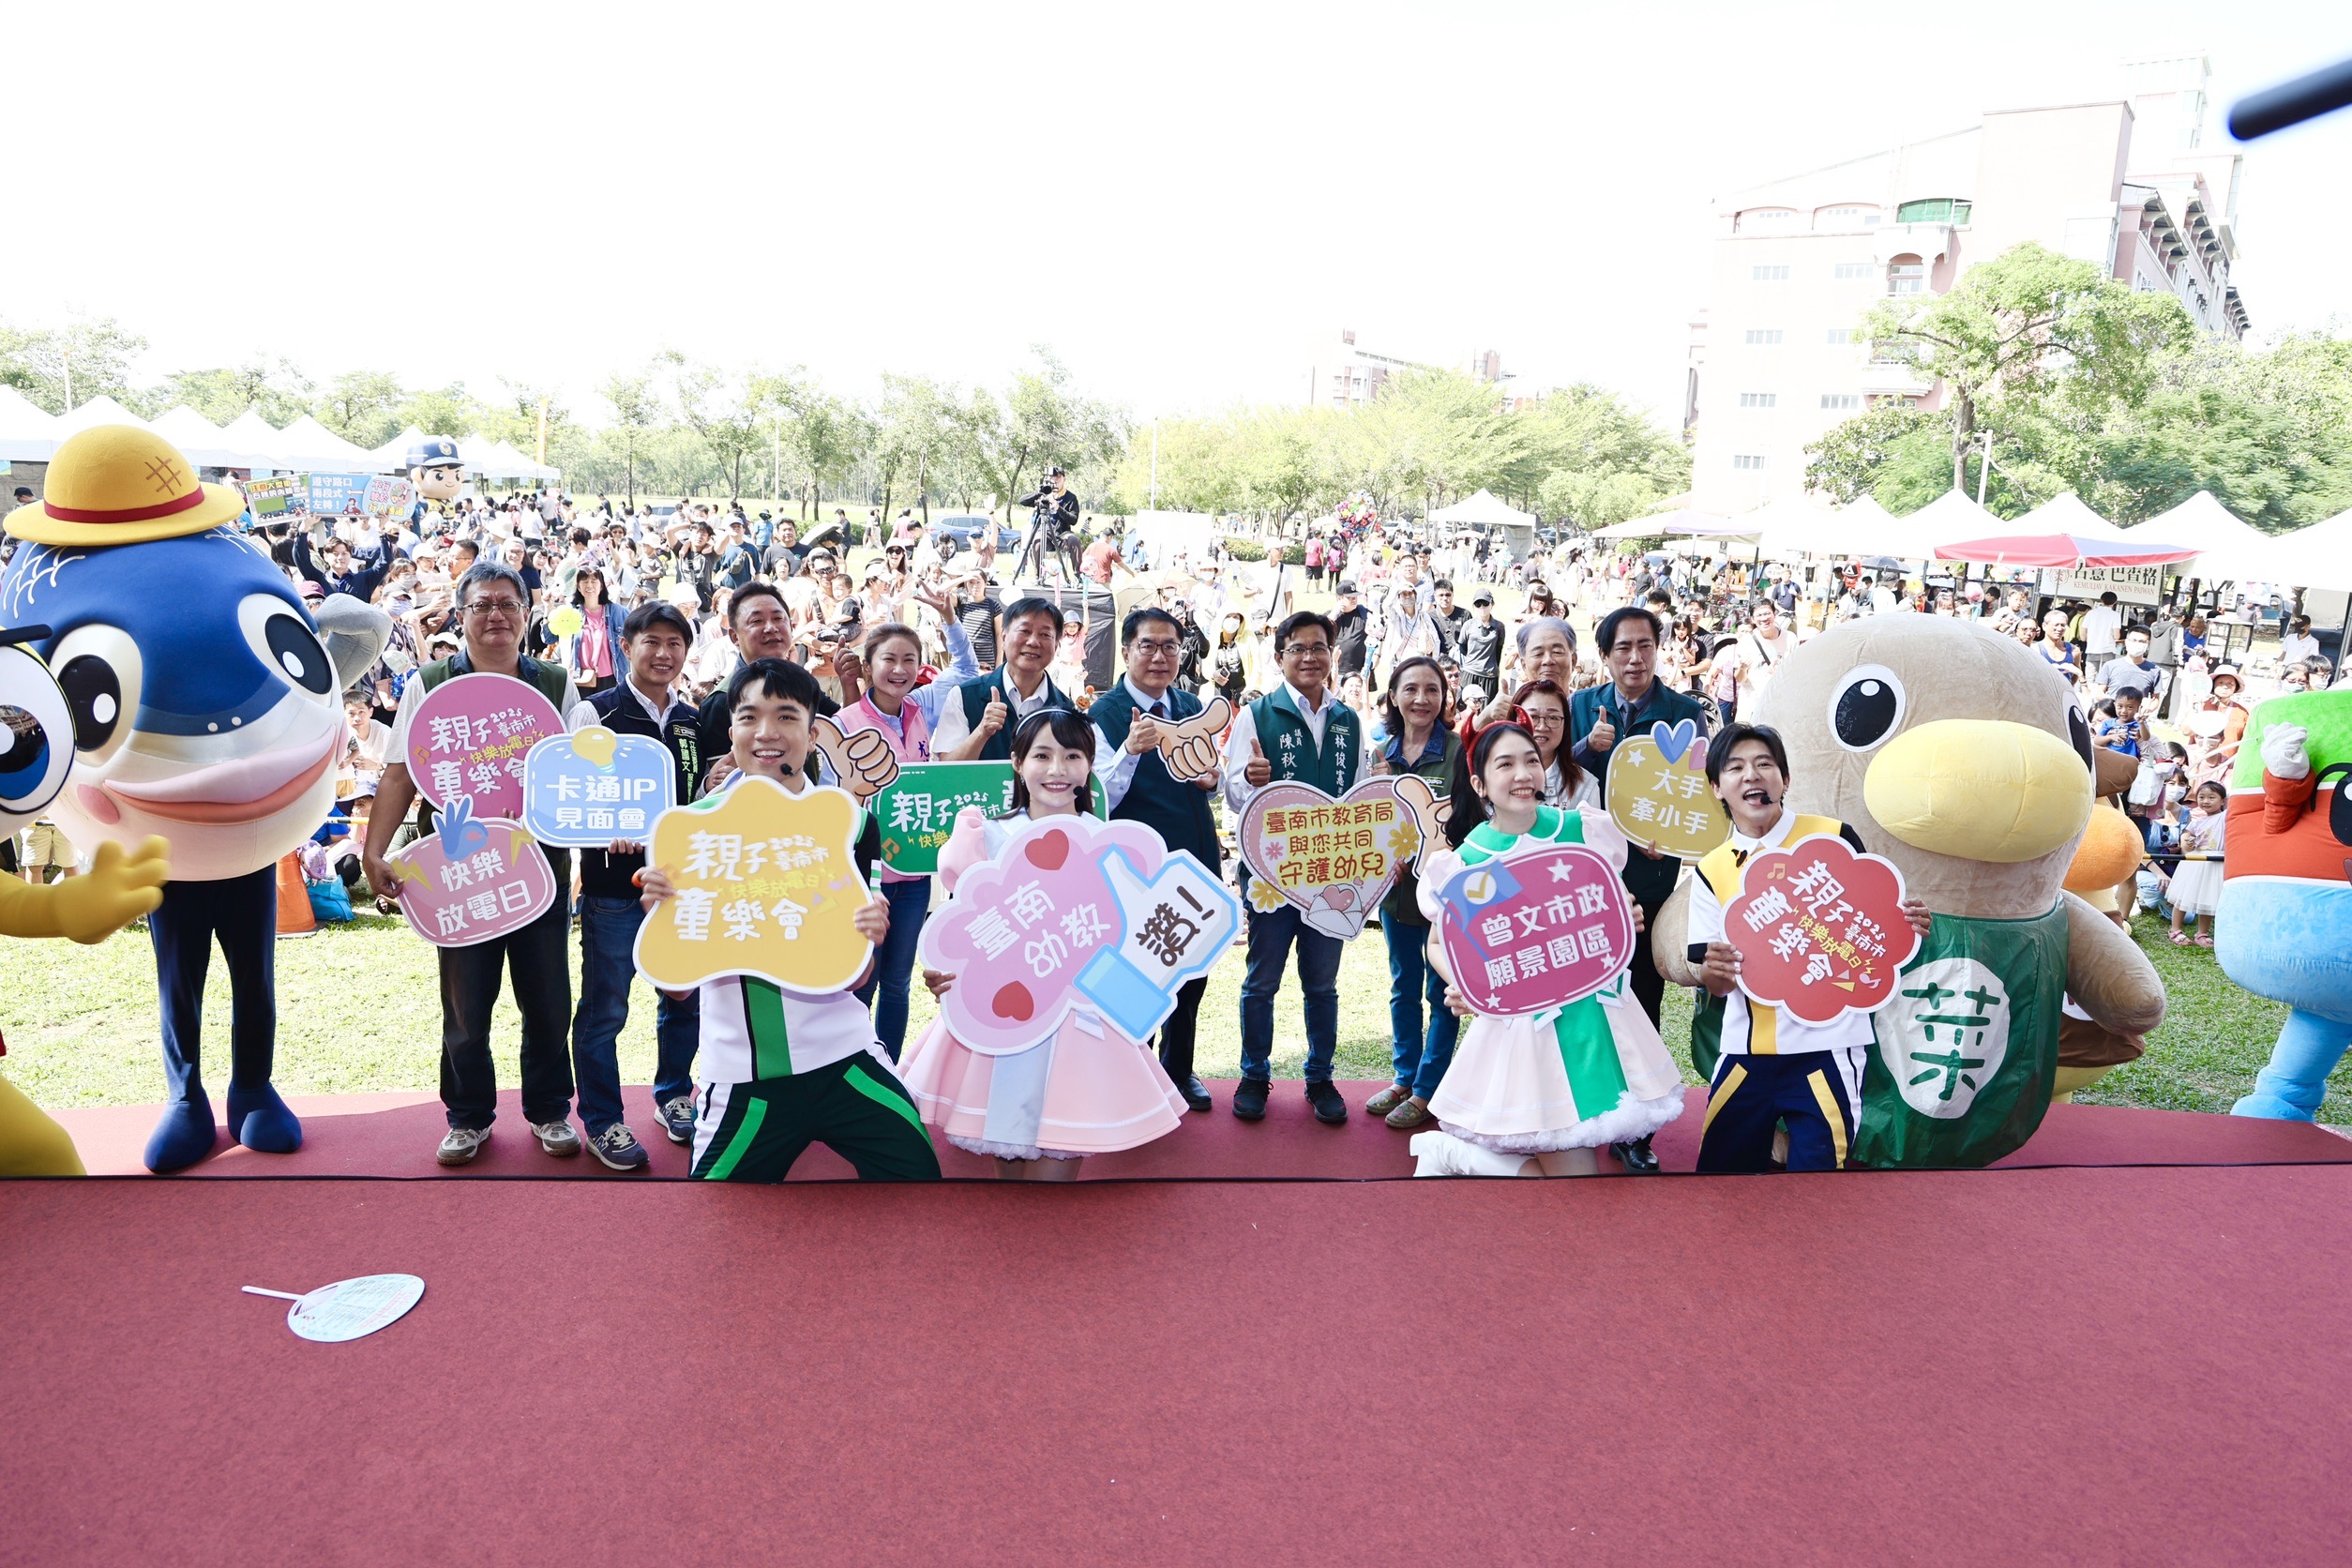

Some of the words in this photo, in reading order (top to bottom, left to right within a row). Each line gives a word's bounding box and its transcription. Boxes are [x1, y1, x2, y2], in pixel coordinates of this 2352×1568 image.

[490, 707, 523, 724] 2025
[495, 714, 537, 738] 臺南市
[429, 715, 492, 754] 親子
[469, 734, 535, 765] 快樂放電日
[546, 774, 657, 803] 卡通IP
[954, 791, 988, 807] 2025
[1651, 768, 1705, 799] 大手
[554, 807, 646, 830] 見面會
[888, 791, 954, 833] 親子
[1266, 802, 1394, 835] 臺南市教育局
[1629, 796, 1709, 836] 牽小手
[681, 829, 769, 882] 親子
[768, 834, 816, 851] 2025
[774, 846, 830, 872] 臺南市
[1289, 829, 1373, 857] 與您共同
[440, 847, 505, 893] 快樂
[730, 869, 822, 900] 快樂放電日
[1279, 852, 1384, 886] 守護幼兒
[435, 879, 533, 937] 放電日
[1787, 859, 1855, 923] 親子
[673, 886, 809, 942] 童樂會
[964, 879, 1056, 962] 臺南
[1481, 882, 1610, 947] 曾文市政
[1853, 910, 1886, 942] 2025
[1024, 902, 1112, 979] 幼教
[1742, 885, 1833, 986] 童樂會
[1798, 913, 1862, 969] 快樂放電日
[1844, 922, 1887, 958] 臺南市
[1484, 922, 1613, 990] 願景園區
[1901, 982, 2001, 1101] 菜
